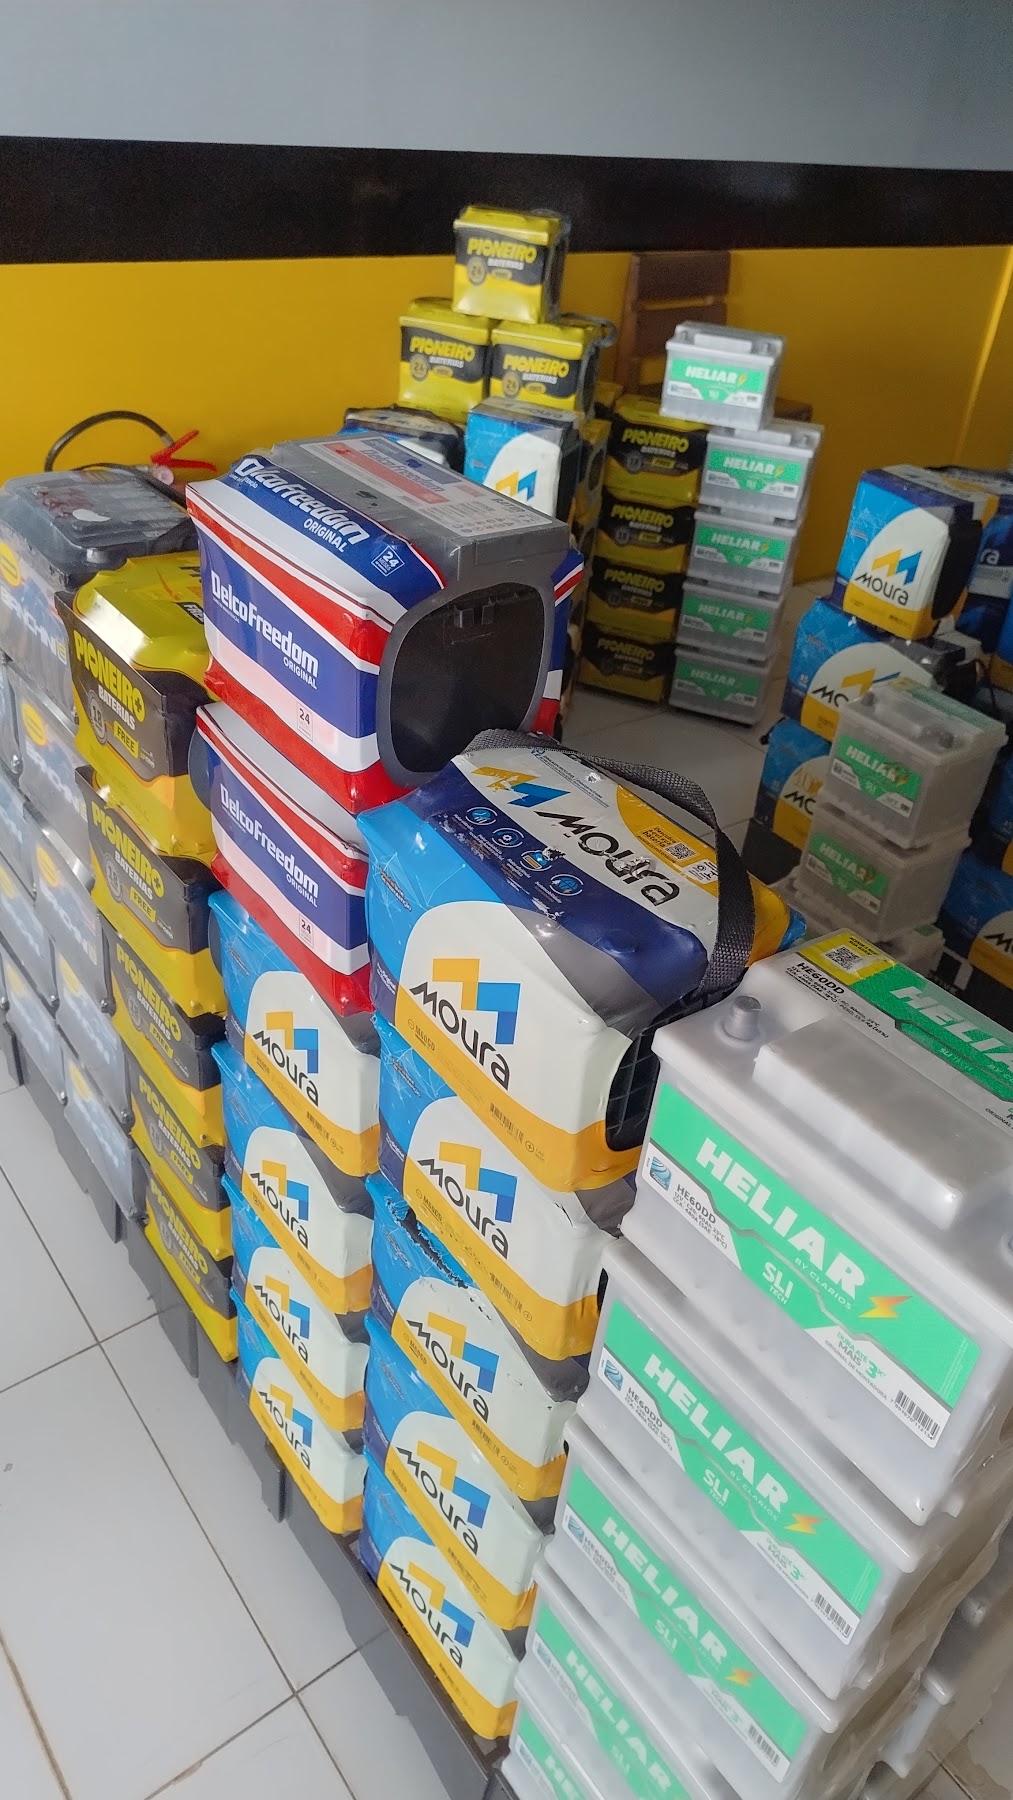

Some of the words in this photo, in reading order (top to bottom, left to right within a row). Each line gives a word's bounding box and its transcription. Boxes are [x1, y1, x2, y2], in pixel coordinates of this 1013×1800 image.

[467, 238, 537, 264] PIONEIRO
[410, 336, 475, 363] PIONEIRO
[503, 354, 569, 378] PIONEIRO
[685, 365, 738, 385] HELIAR
[622, 428, 689, 453] PIONEIRO
[723, 456, 775, 476] HELIAR
[610, 504, 674, 528] PIONEIRO
[303, 518, 348, 553] ORIGINAL
[711, 532, 761, 551] HELIAR
[383, 551, 399, 567] 24
[604, 568, 665, 593] PIONEIRO
[211, 570, 319, 678] DelcoFreedom
[699, 604, 745, 622] HELIAR
[73, 629, 146, 723] PIONEIRO
[283, 656, 318, 690] ORIGINAL
[690, 668, 736, 688] HELIAR
[98, 684, 136, 731] BATERIAS
[300, 708, 310, 725] 24
[117, 725, 135, 751] FREE
[91, 802, 165, 898] PIONEIRO
[220, 783, 319, 899] DelcoFreedom
[114, 850, 154, 900] BATERIAS
[286, 874, 318, 908] ORIGINAL
[133, 893, 153, 917] FREE
[301, 919, 311, 934] 24
[116, 943, 182, 1042] PIONEIRO
[136, 990, 171, 1041] BATERIAS
[151, 1026, 171, 1053] FREE
[139, 1075, 202, 1170] PIONEIRO
[985, 1107, 1011, 1127] ORIGINAL
[157, 1121, 192, 1168] BATERIAS
[172, 1153, 191, 1180] FREE
[677, 1184, 717, 1224] HE60DD
[696, 1137, 866, 1300] HELIAR
[150, 1178, 209, 1274] PIONEIRO
[762, 1262, 795, 1298] SLI
[769, 1285, 789, 1305] TECH
[794, 1257, 809, 1271] BY
[808, 1270, 852, 1310] CLARIOS
[837, 1331, 856, 1351] DURA
[838, 1341, 862, 1366] MAIS
[825, 1340, 848, 1364] ORIGINAL
[855, 1368, 888, 1400] MONTADORA
[628, 1386, 663, 1428] HE60DD
[643, 1353, 789, 1513] HELIAR
[702, 1468, 730, 1503] SLI
[709, 1488, 726, 1508] TECH
[742, 1483, 778, 1522] CLARIOS
[602, 1517, 727, 1665] HELIAR
[654, 1619, 678, 1650] SLI
[566, 1650, 672, 1792] HELIAR
